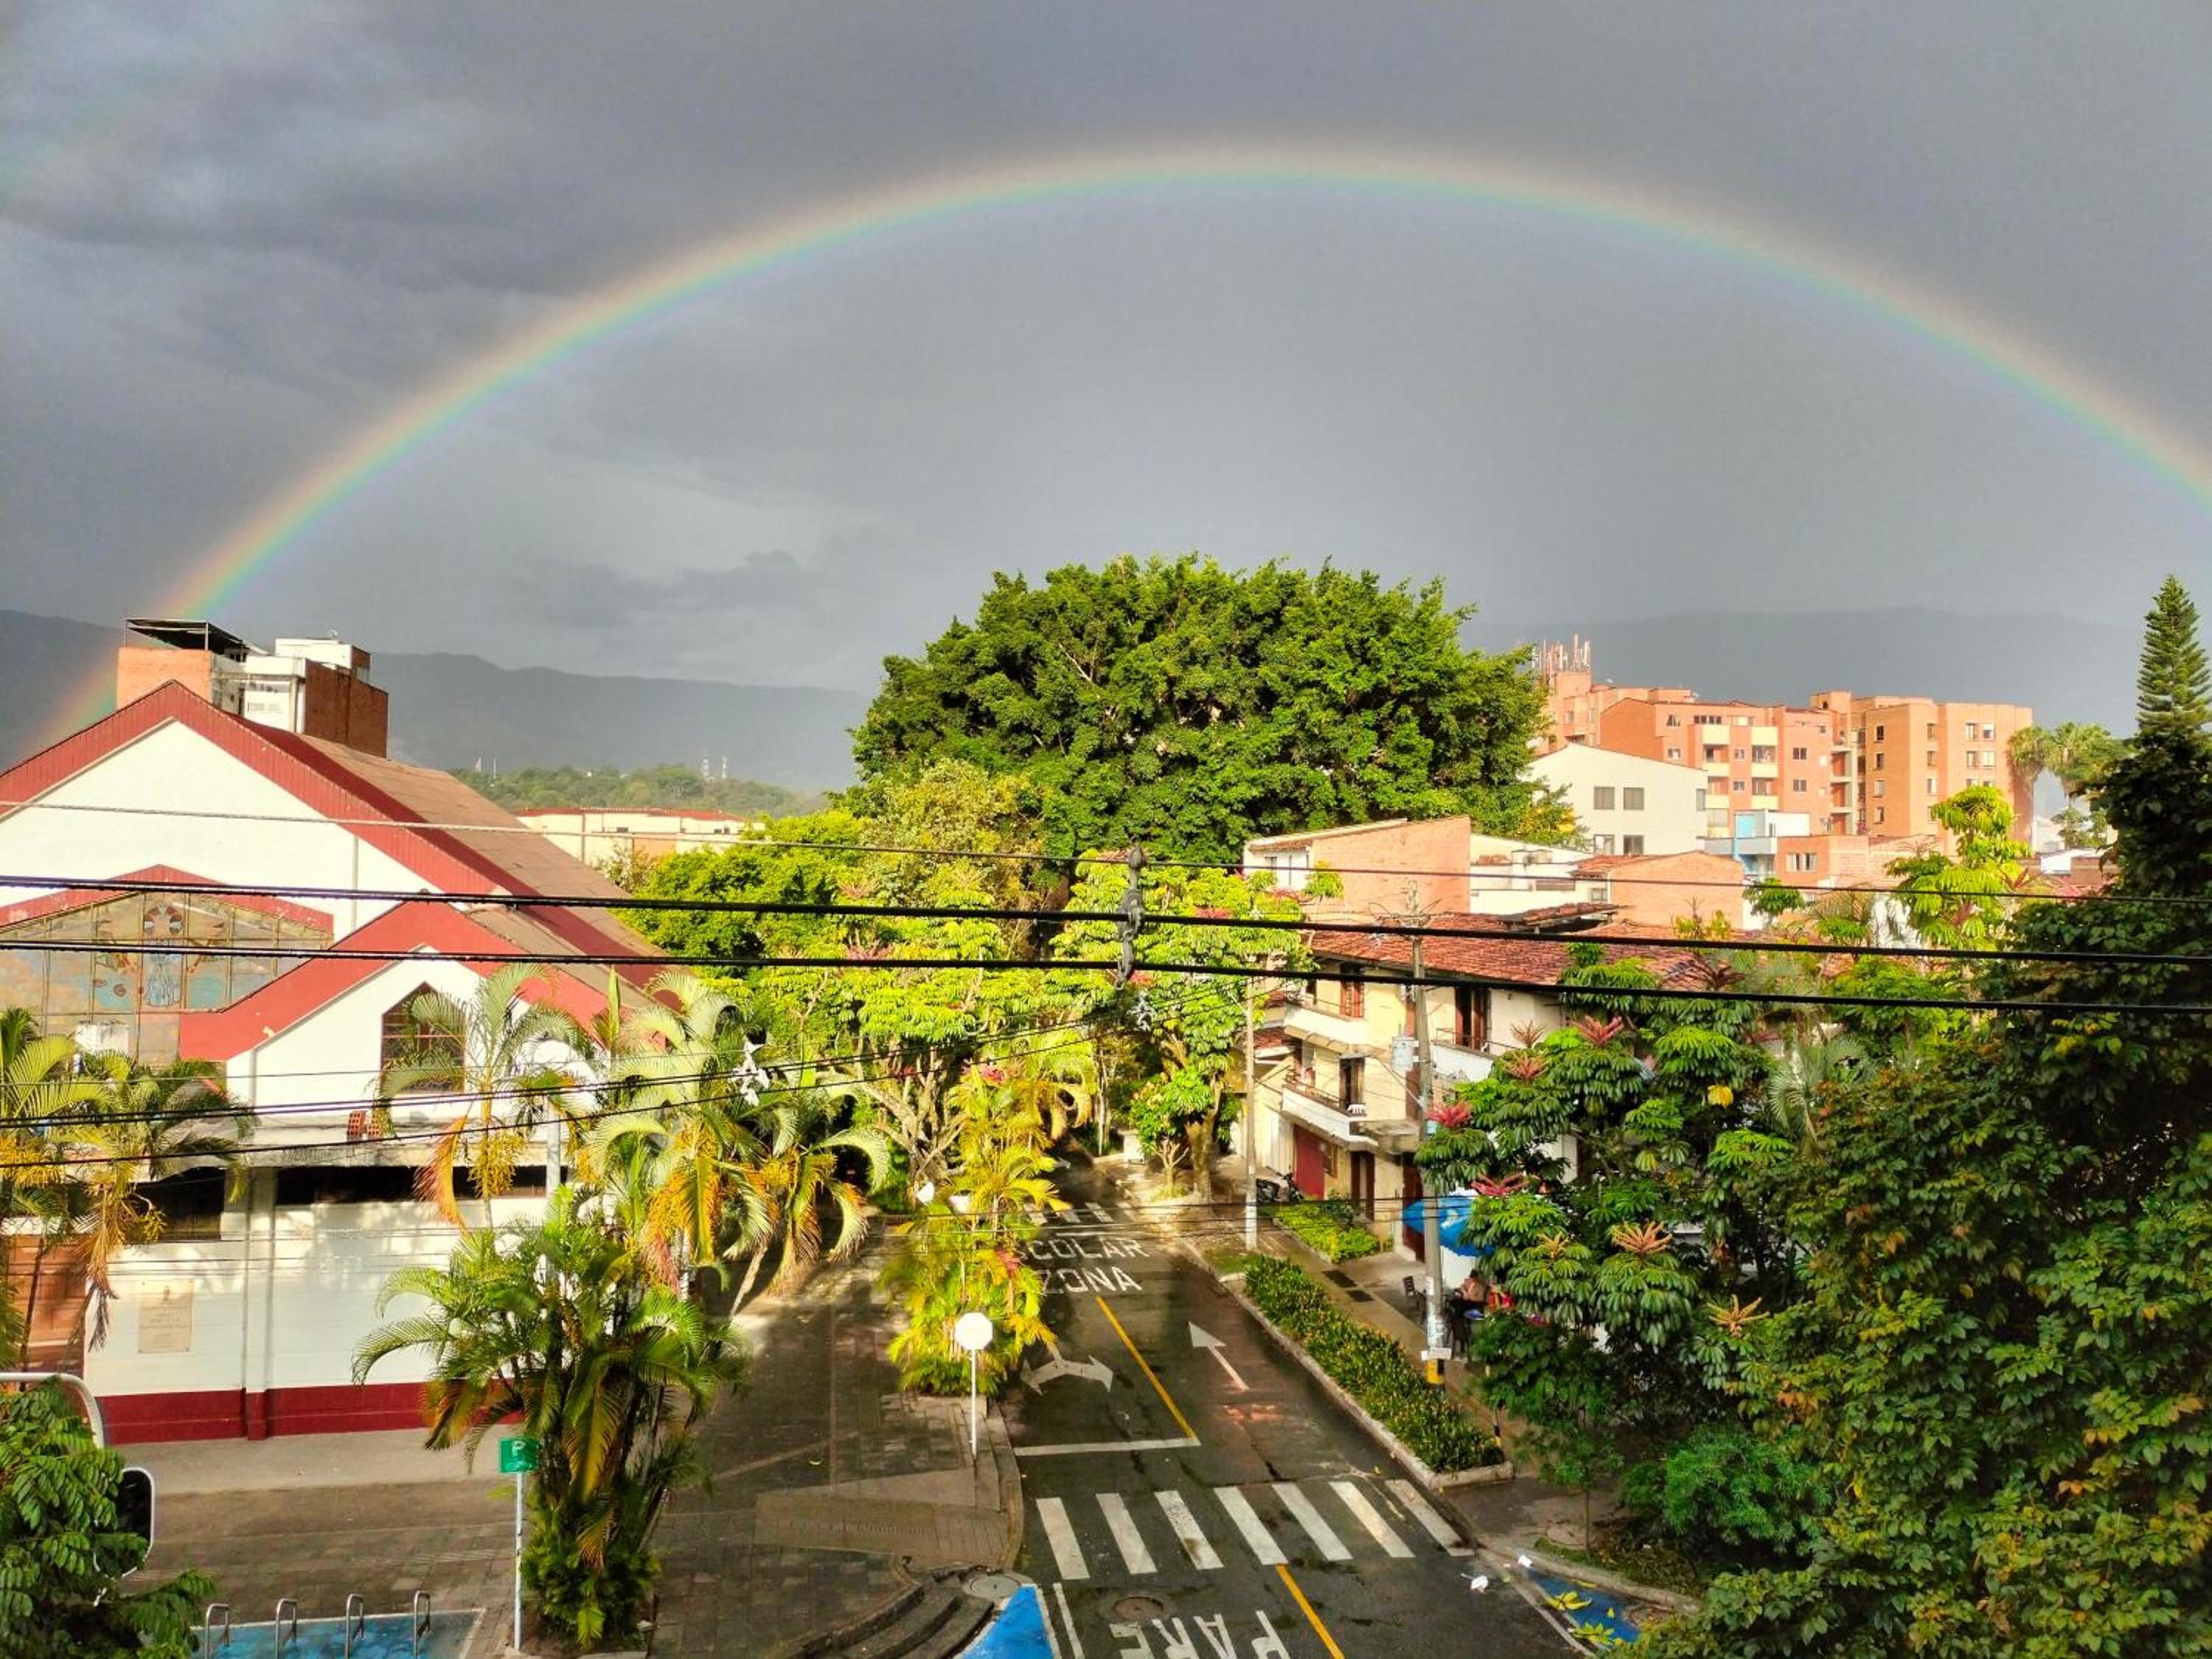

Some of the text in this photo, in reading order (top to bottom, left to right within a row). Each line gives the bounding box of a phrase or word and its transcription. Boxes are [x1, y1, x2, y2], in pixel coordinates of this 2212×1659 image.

[1015, 1237, 1150, 1260] SCOLAR
[1039, 1266, 1143, 1295] ZONA
[511, 1440, 526, 1457] P
[1110, 1610, 1292, 1659] PARE
